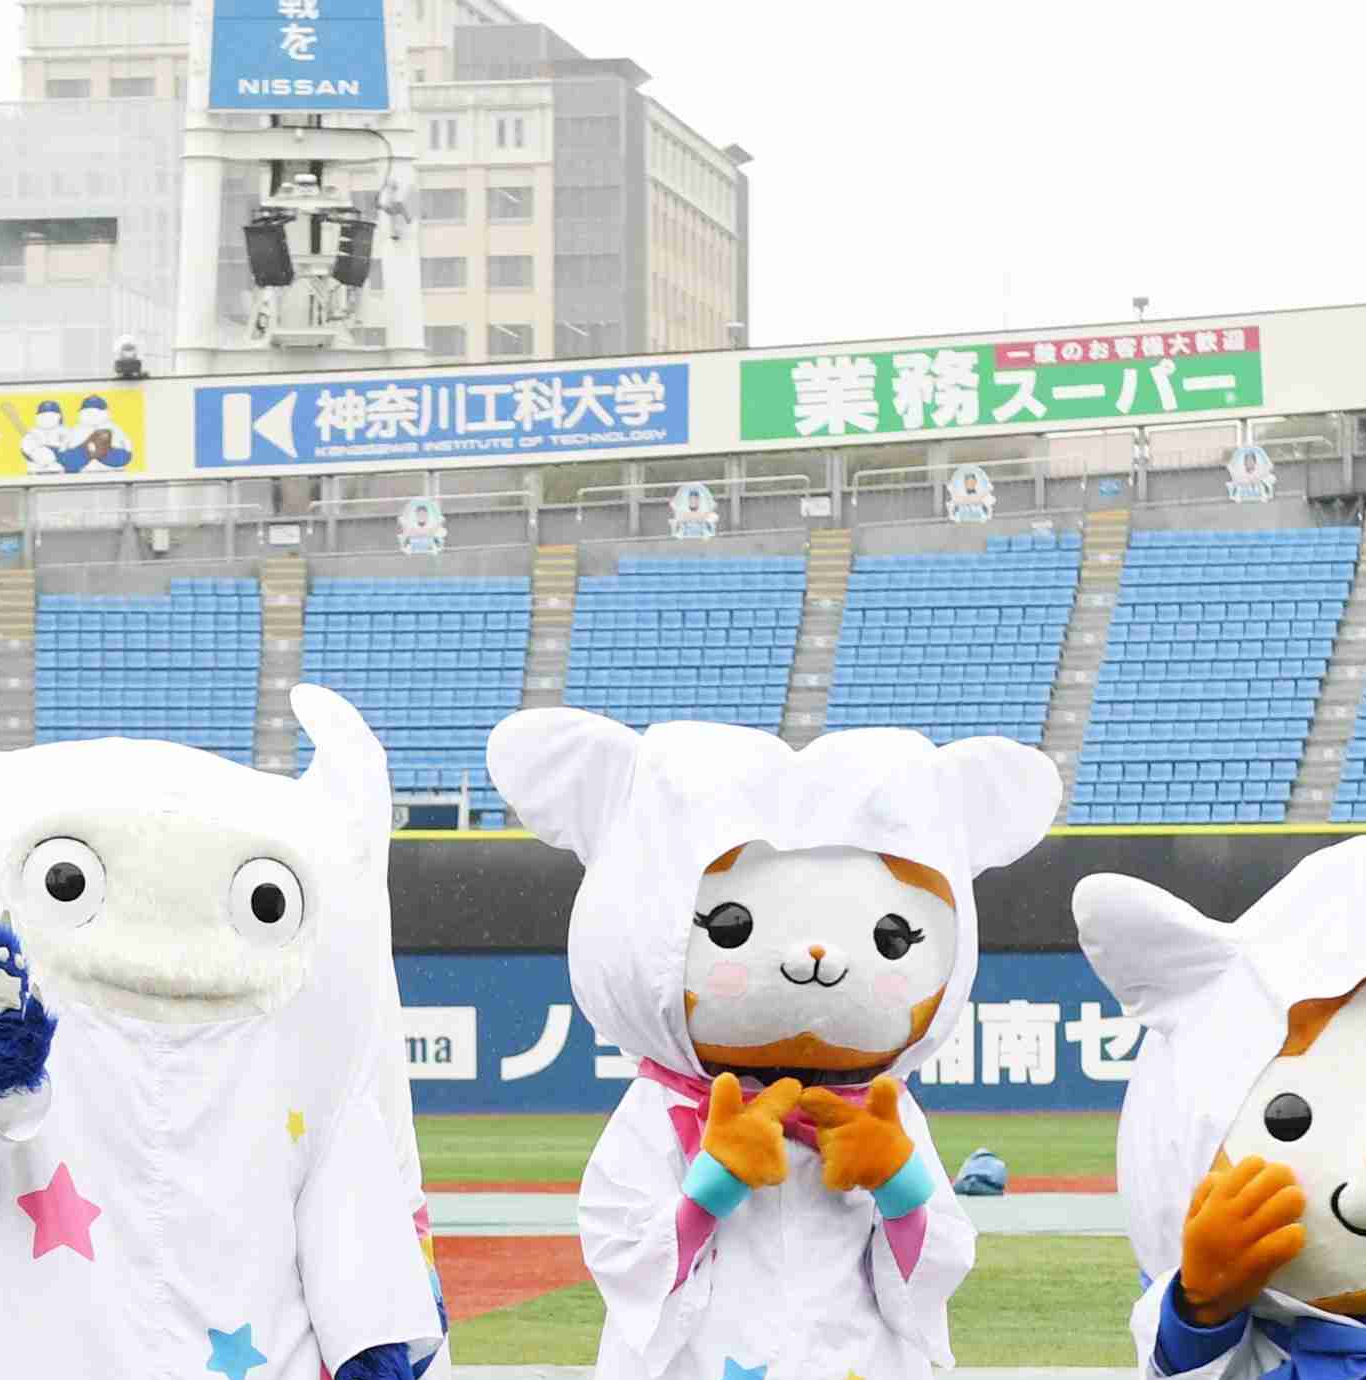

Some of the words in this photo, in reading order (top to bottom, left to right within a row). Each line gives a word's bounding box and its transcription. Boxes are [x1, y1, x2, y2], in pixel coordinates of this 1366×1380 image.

[238, 79, 360, 96] NISSAN
[315, 371, 666, 442] 神奈川工科大学
[790, 349, 1237, 435] 業務スーパー
